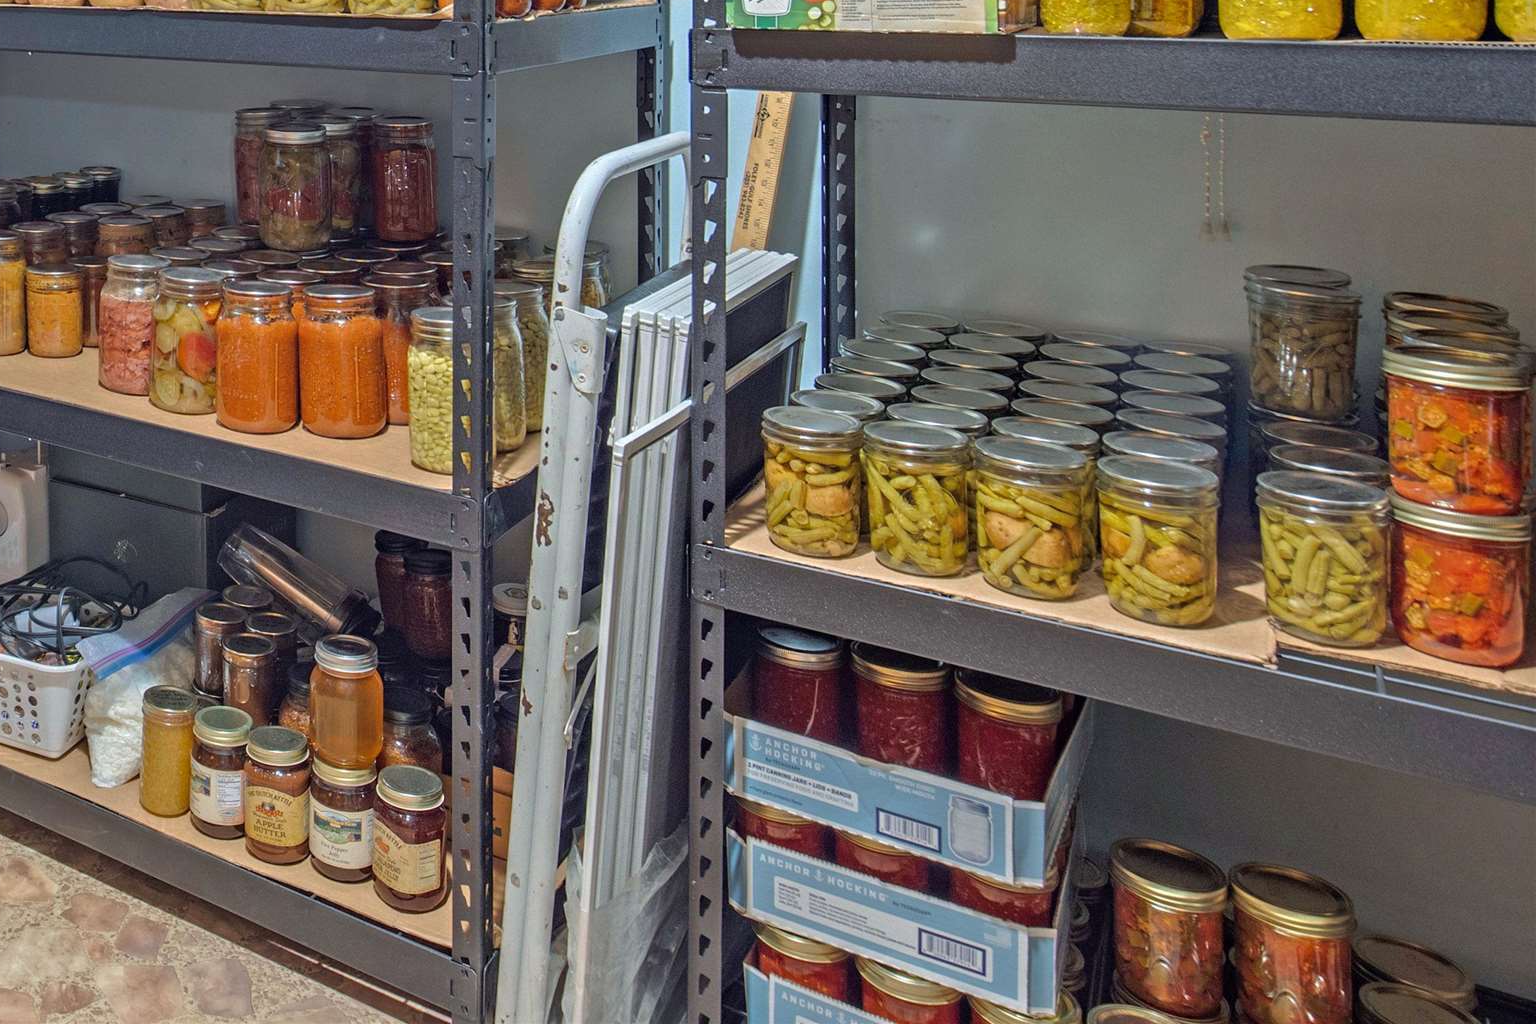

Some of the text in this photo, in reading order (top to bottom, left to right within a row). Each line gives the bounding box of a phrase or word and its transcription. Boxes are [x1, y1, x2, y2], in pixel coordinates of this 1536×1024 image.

[765, 737, 817, 761] ANCHOR
[752, 762, 765, 773] PINT
[766, 768, 791, 781] CANNING
[792, 775, 808, 786] JARS
[253, 825, 286, 838] BUTTER
[255, 819, 284, 830] APPLE
[759, 852, 810, 877] ANCHOR
[781, 991, 833, 1018] ANCHOR
